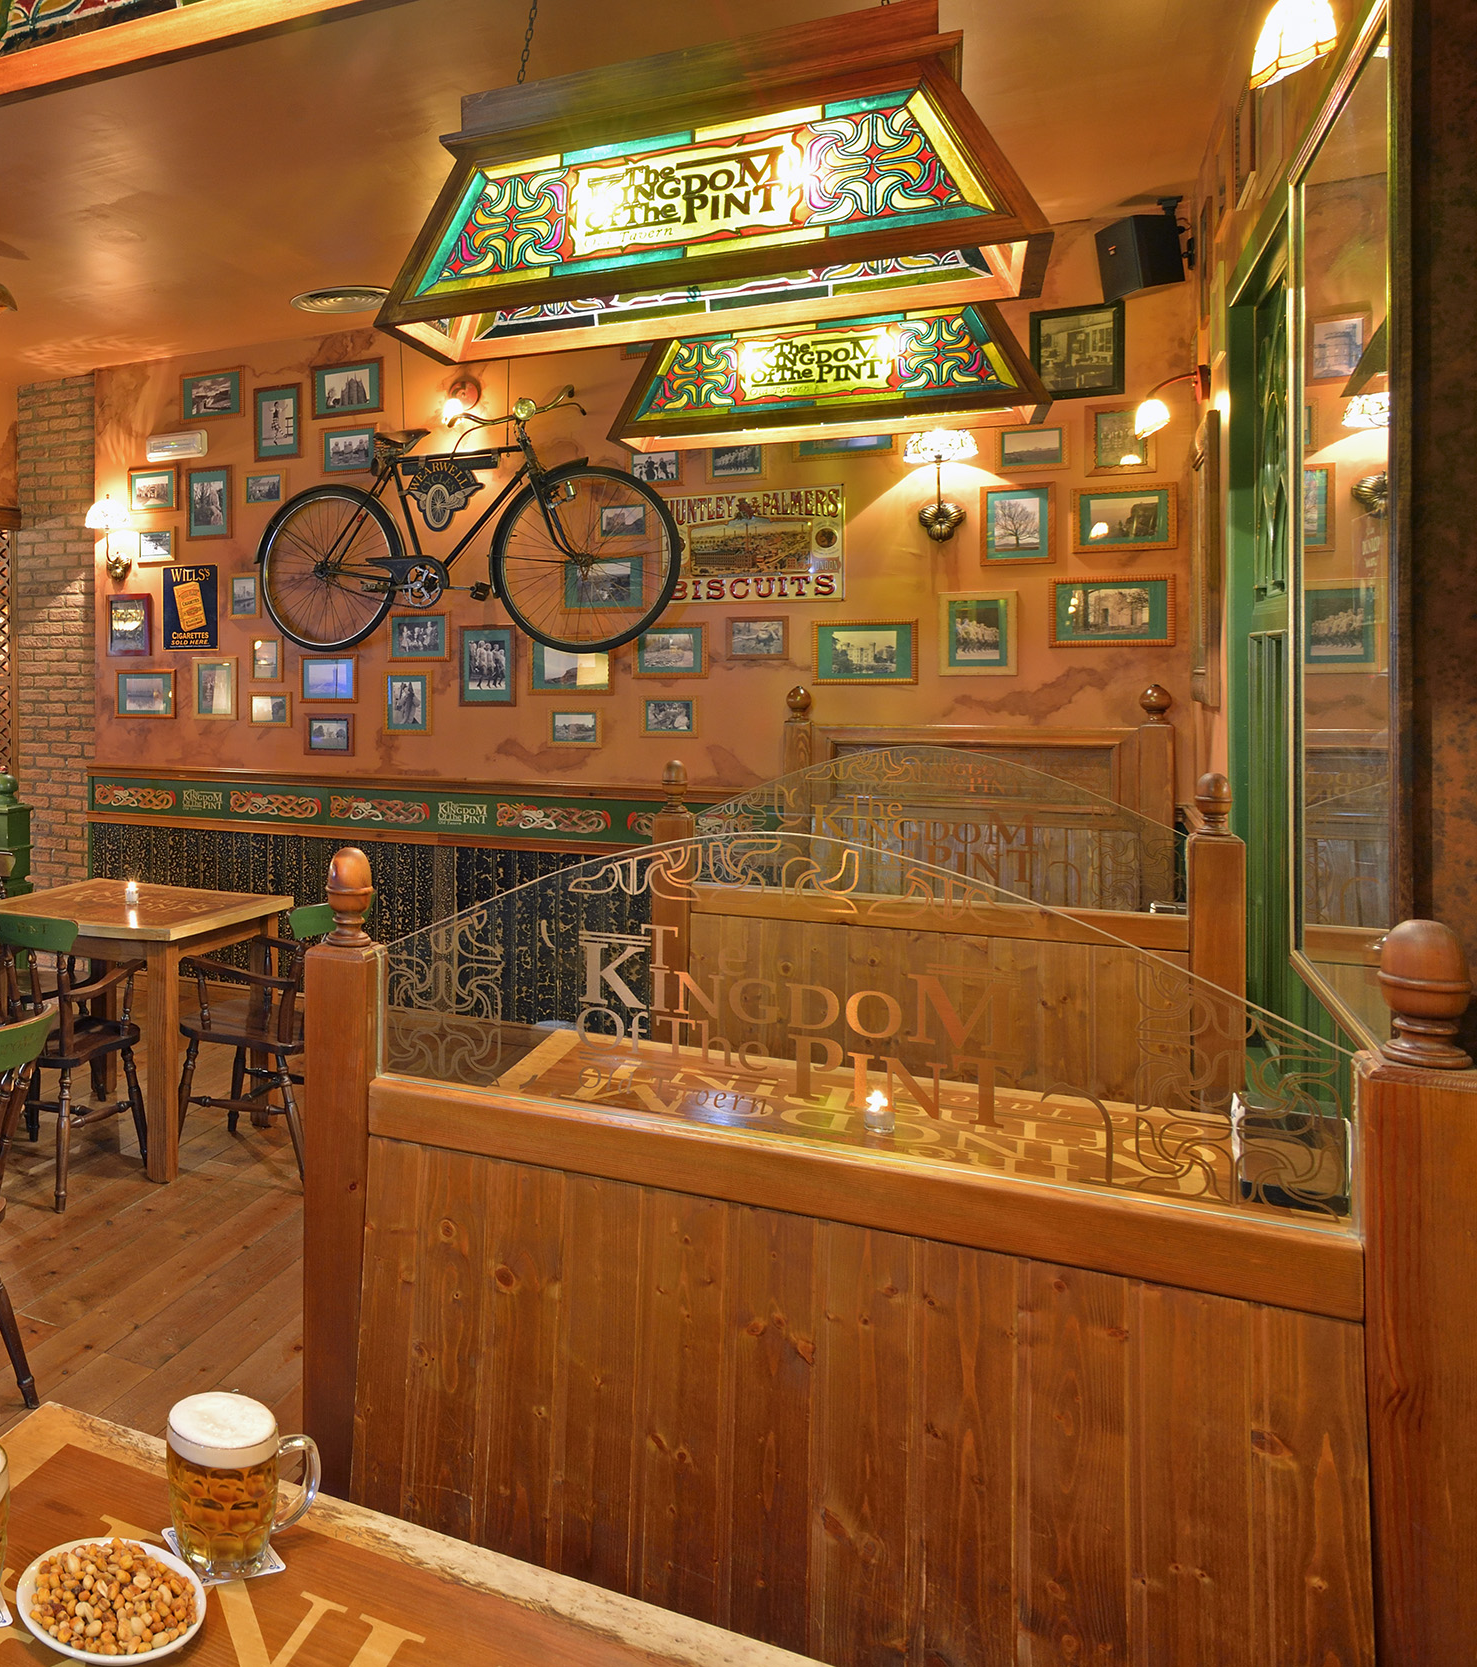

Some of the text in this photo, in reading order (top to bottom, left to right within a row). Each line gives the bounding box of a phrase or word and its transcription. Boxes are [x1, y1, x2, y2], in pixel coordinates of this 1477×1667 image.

[625, 164, 675, 186] The
[624, 202, 678, 227] The
[683, 184, 784, 225] PINT
[774, 340, 811, 355] The
[775, 366, 814, 381] The
[816, 359, 883, 384] PINT
[409, 461, 468, 491] WEARWELL
[420, 473, 457, 493] CYCLES
[762, 487, 841, 518] PALMERS
[672, 574, 837, 600] BISCUITS
[171, 631, 210, 640] CIGARETTES
[203, 801, 223, 810] PINT
[438, 802, 488, 816] KINGDOM
[845, 793, 904, 818] The
[463, 814, 488, 825] PINT
[811, 803, 1038, 848] KINGDOM
[924, 844, 1039, 884] PINT
[578, 940, 1022, 1055] KINGDOM
[576, 1006, 1020, 1130] Of The PINT
